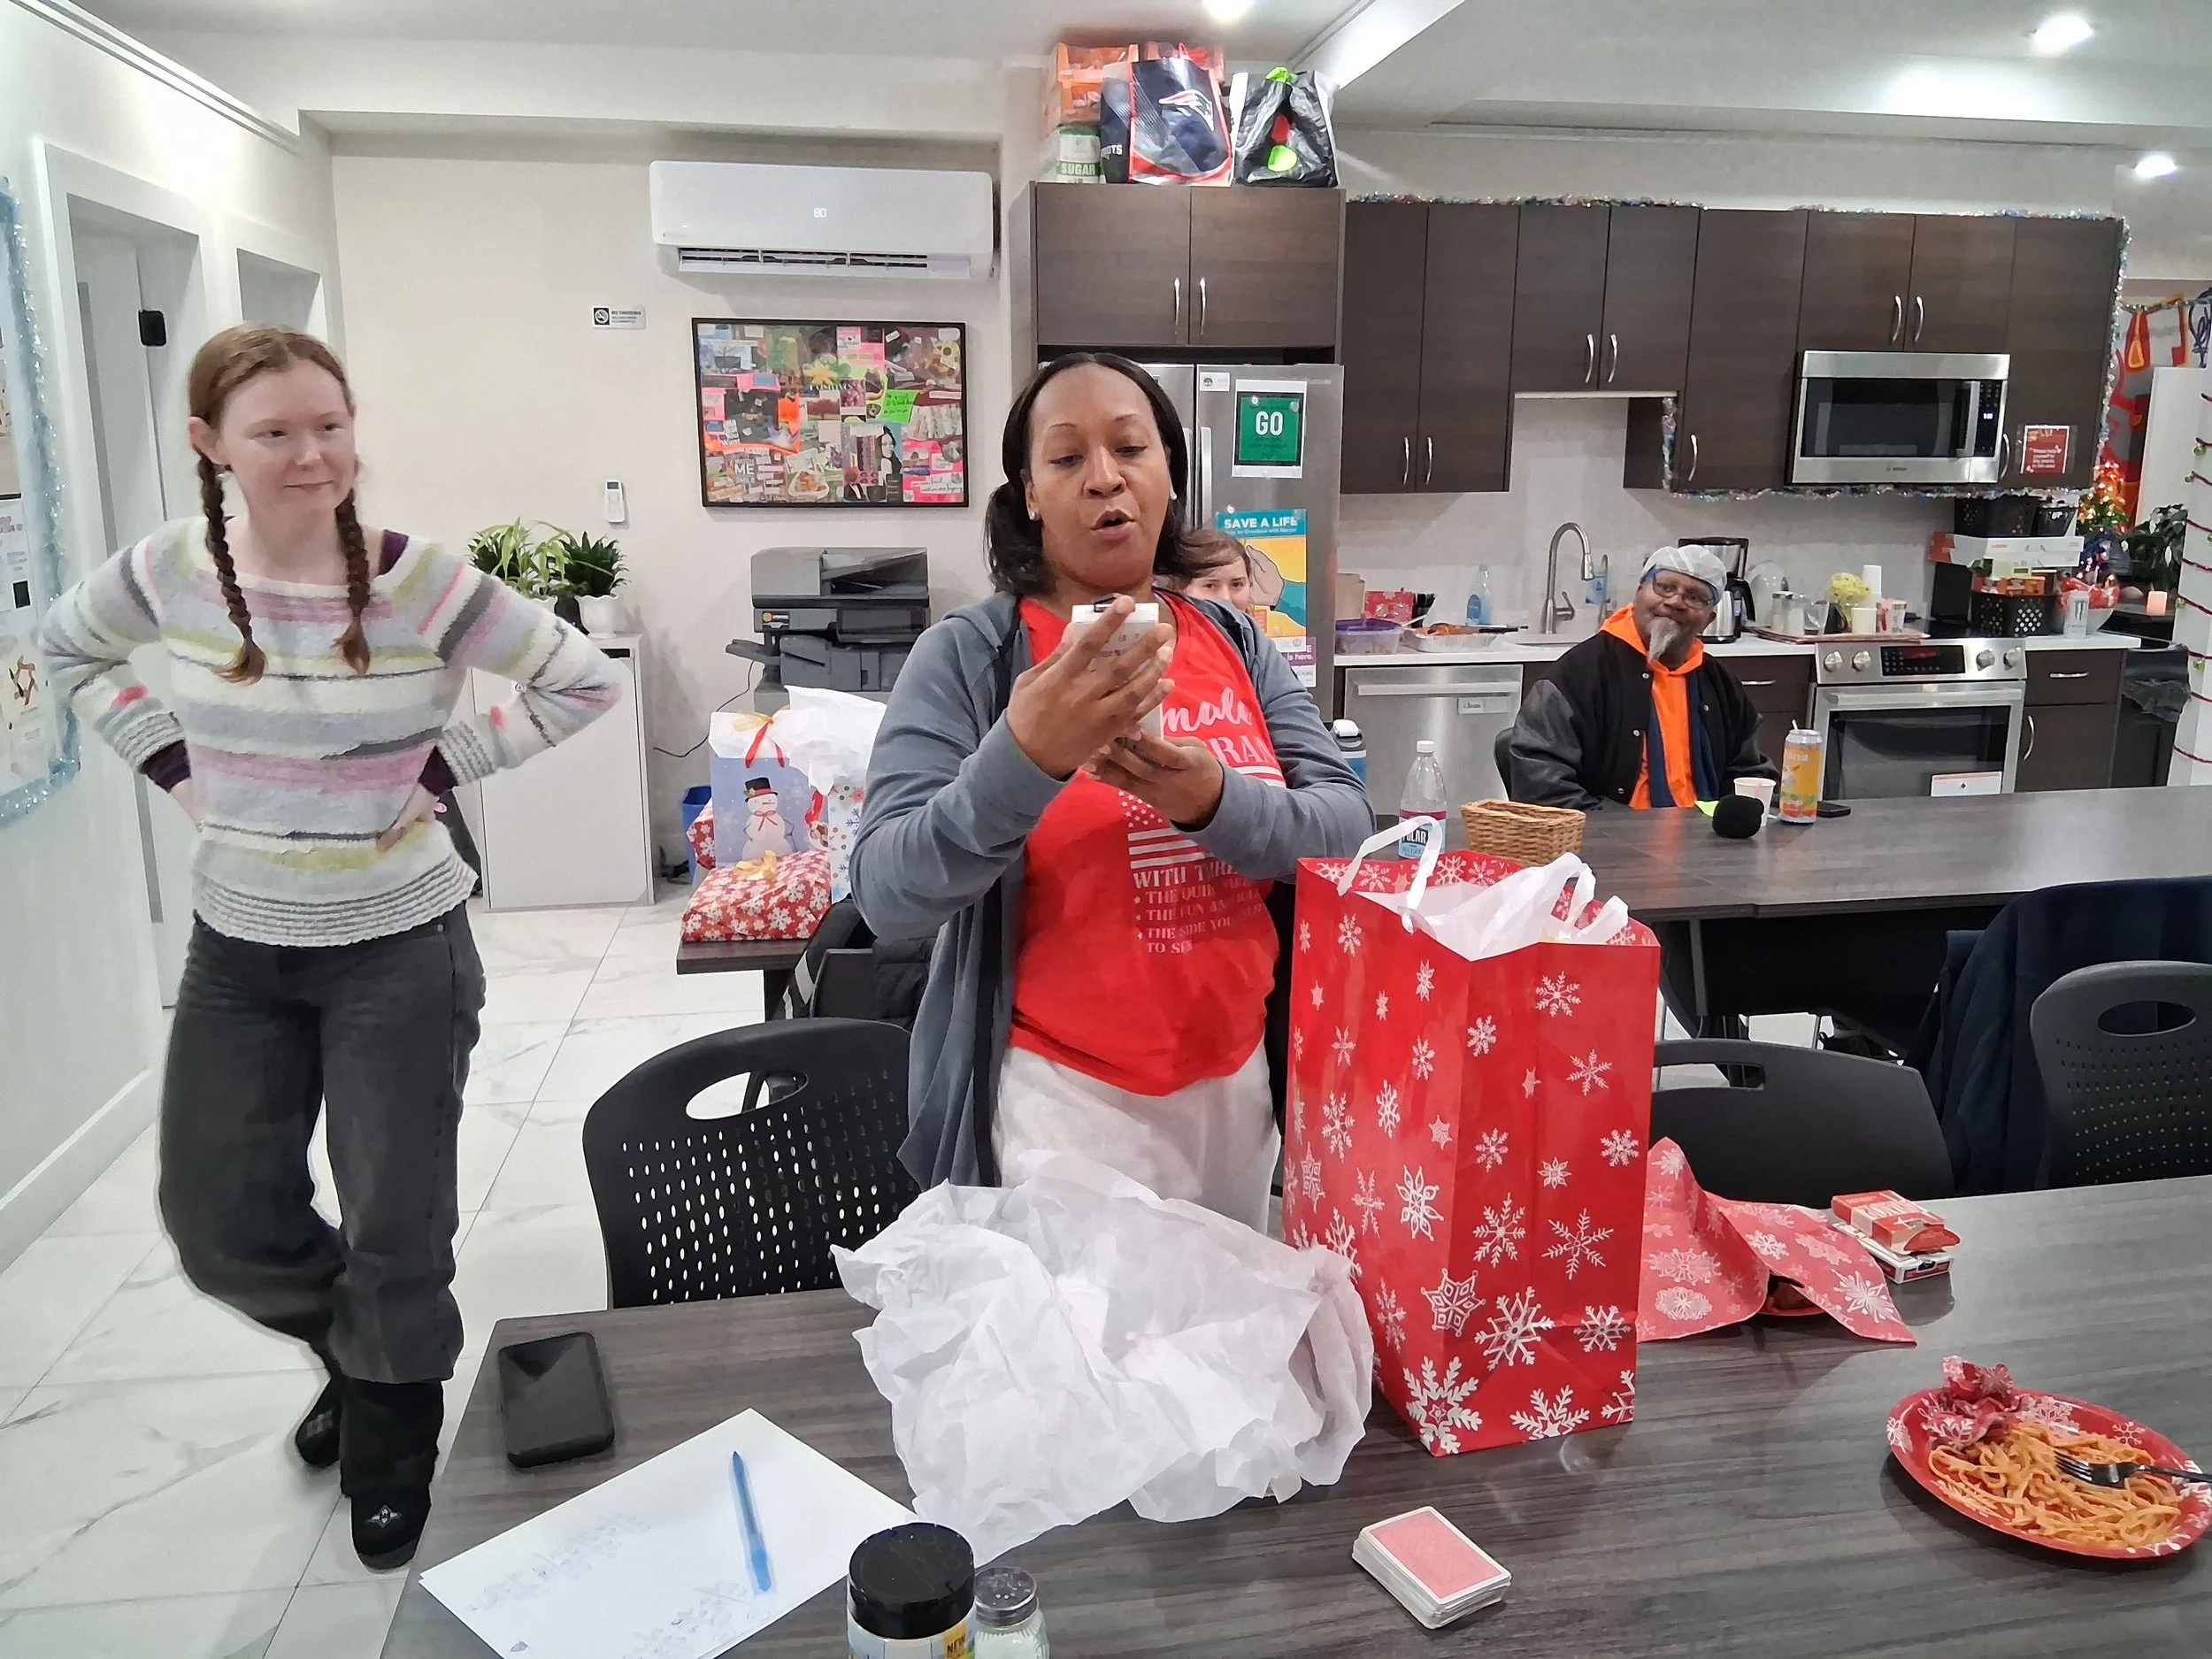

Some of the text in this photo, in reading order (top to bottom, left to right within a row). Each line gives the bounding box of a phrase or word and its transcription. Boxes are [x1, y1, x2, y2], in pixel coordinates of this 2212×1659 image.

[1062, 163, 1095, 175] SUGAR
[1256, 411, 1283, 435] GO
[734, 463, 755, 475] ME
[1224, 516, 1298, 529] SAVE A LIFE
[1133, 865, 1187, 888] WITH
[1145, 888, 1178, 904] THE
[1147, 926, 1176, 940] THE
[1179, 920, 1207, 938] SIDE
[1146, 942, 1166, 955] TO
